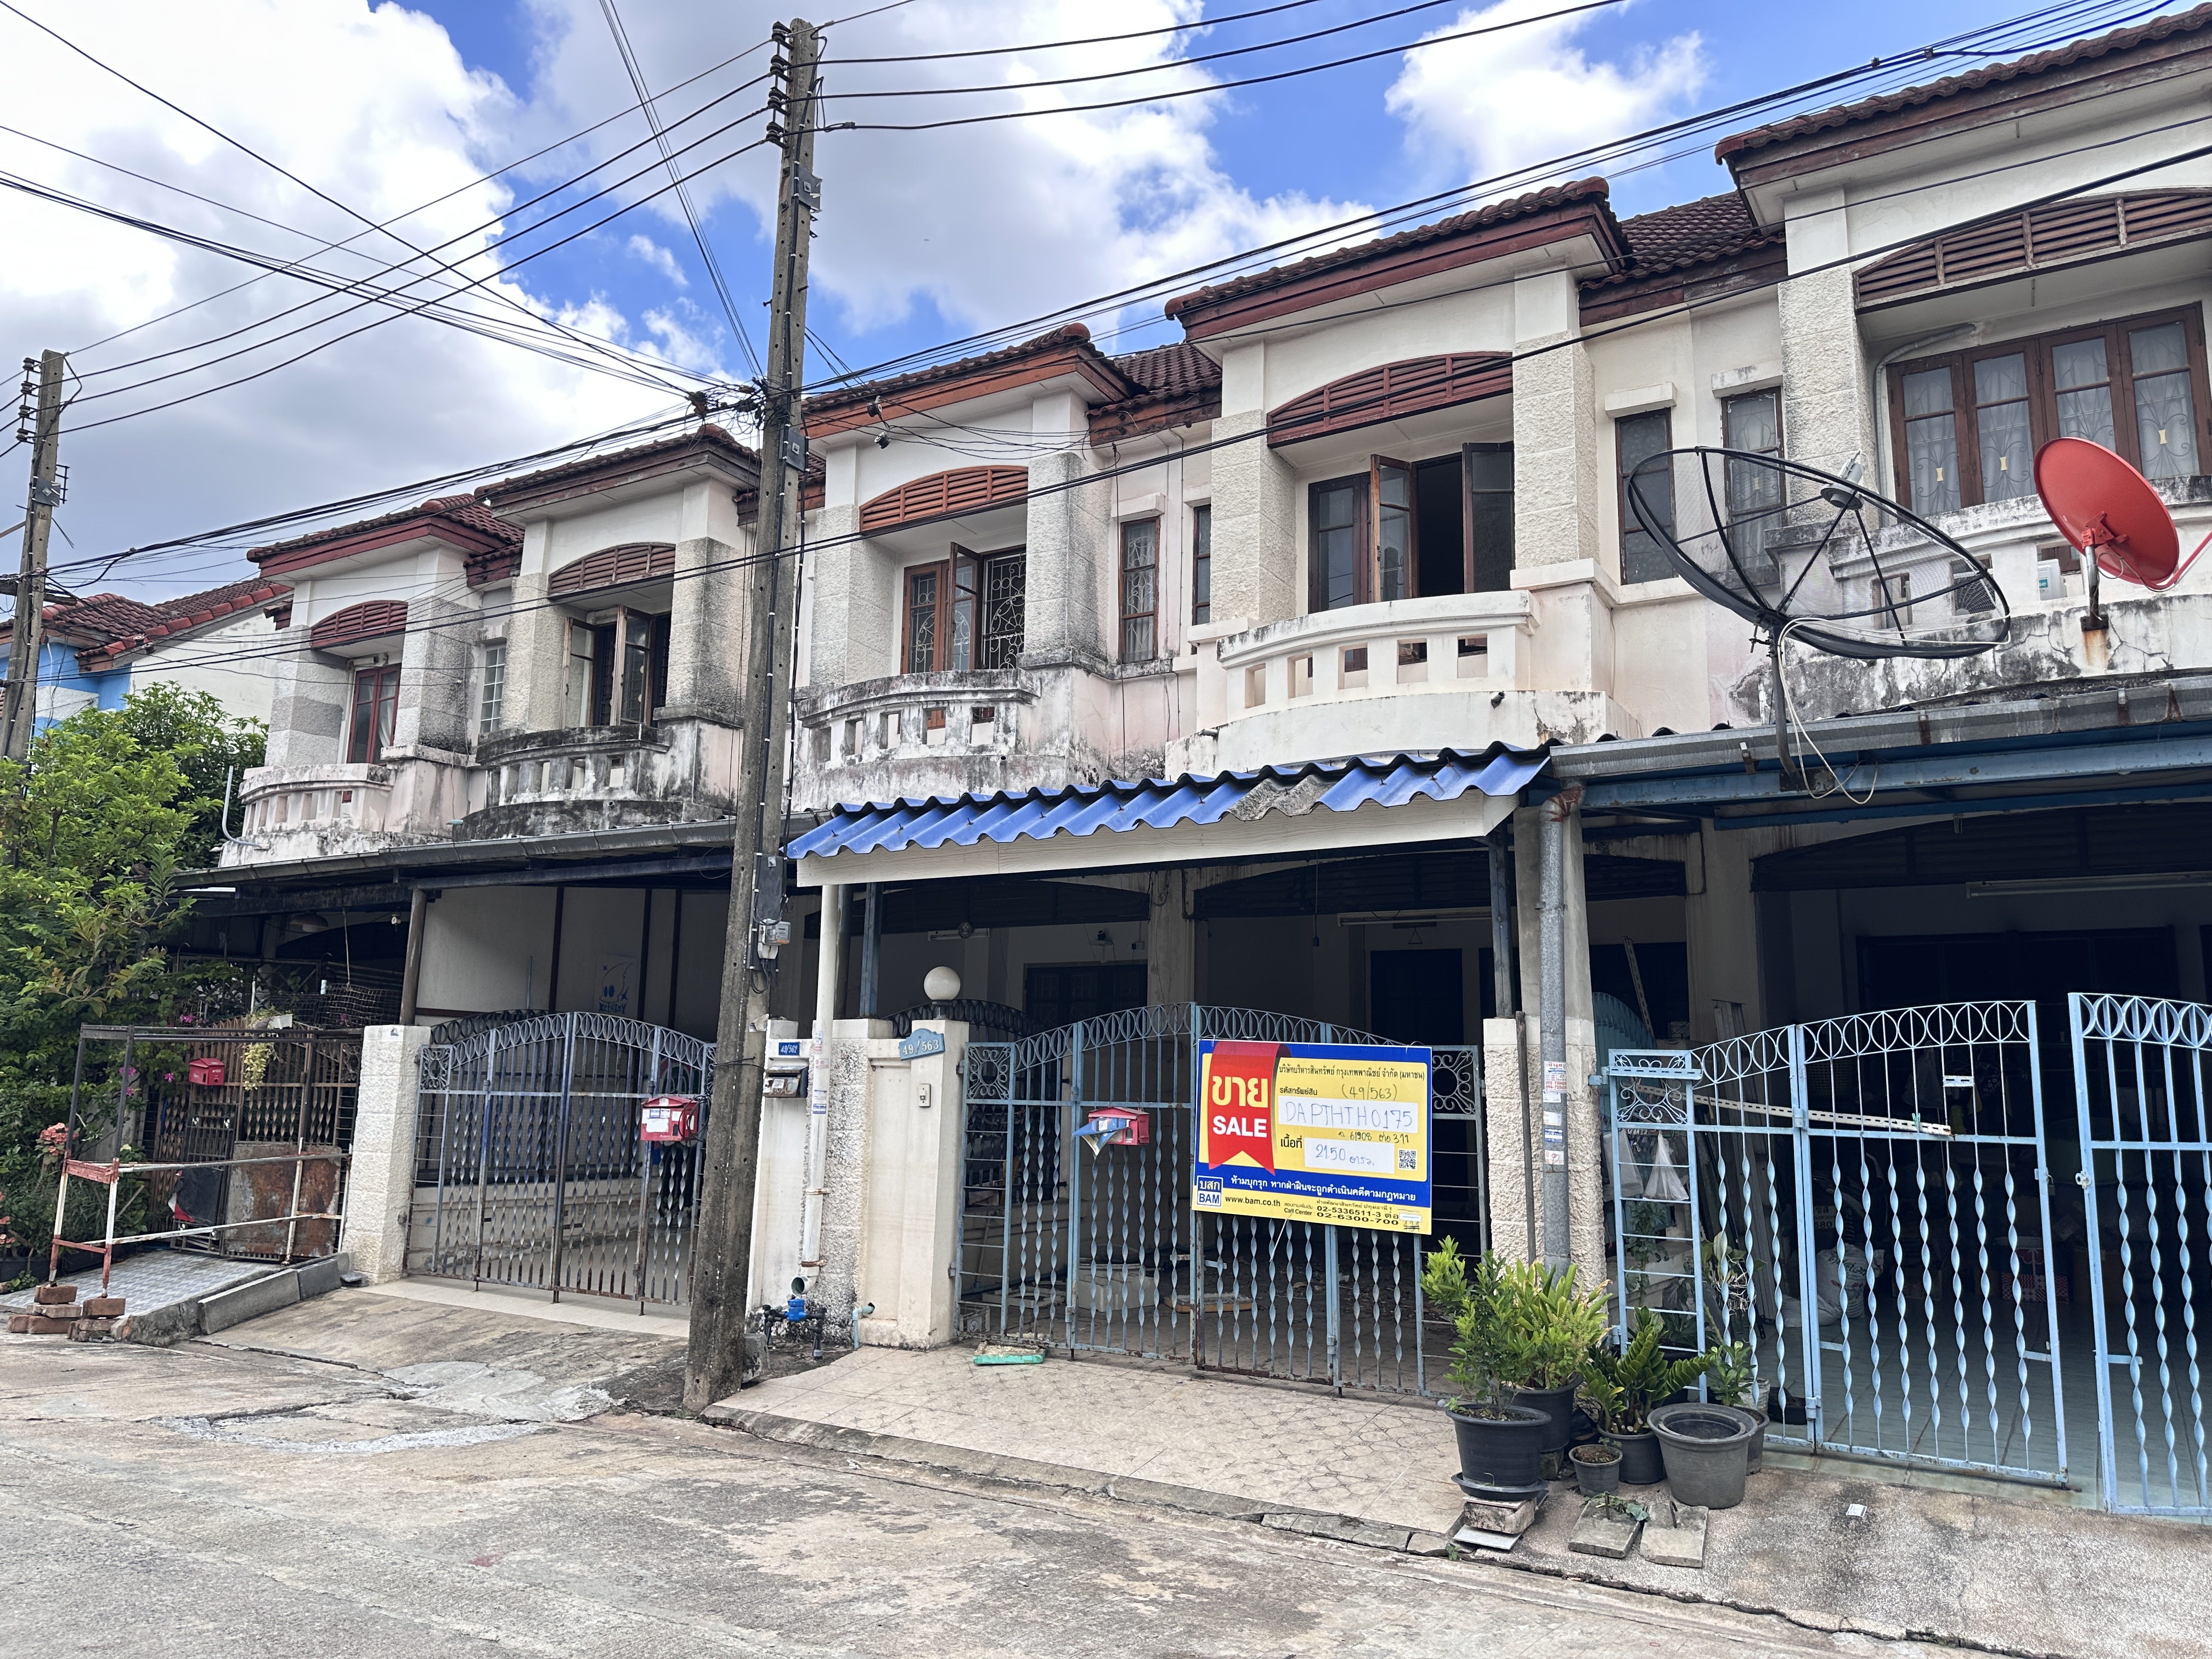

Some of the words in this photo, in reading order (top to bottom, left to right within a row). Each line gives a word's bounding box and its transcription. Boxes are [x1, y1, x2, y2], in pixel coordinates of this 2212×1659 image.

[780, 1044, 798, 1054] 49/562
[902, 1039, 940, 1056] 49/563
[1279, 1064, 1335, 1076] บริษัทบริหารสินทรัพย์
[1336, 1067, 1380, 1079] กรุงเทพพาณิชย์
[1381, 1068, 1398, 1079] จำกัด
[1400, 1071, 1425, 1081] (มหาชน)
[1212, 1075, 1268, 1108] ขาย
[1279, 1086, 1318, 1096] รหัสทรัพย์สิน
[1341, 1080, 1398, 1102] (49/563)
[1212, 1115, 1267, 1138] SALE
[1280, 1134, 1302, 1149] เนื้อที่
[1199, 1180, 1220, 1191] บสก
[1231, 1174, 1268, 1190] ห้ามบุกรุก
[1199, 1193, 1220, 1204] BAM
[1225, 1195, 1280, 1207] www.bam.co.th
[1317, 1206, 1381, 1217] 02-5336511-3
[1385, 1211, 1399, 1220] ต่อ
[1317, 1212, 1399, 1225] 02-6300-700
